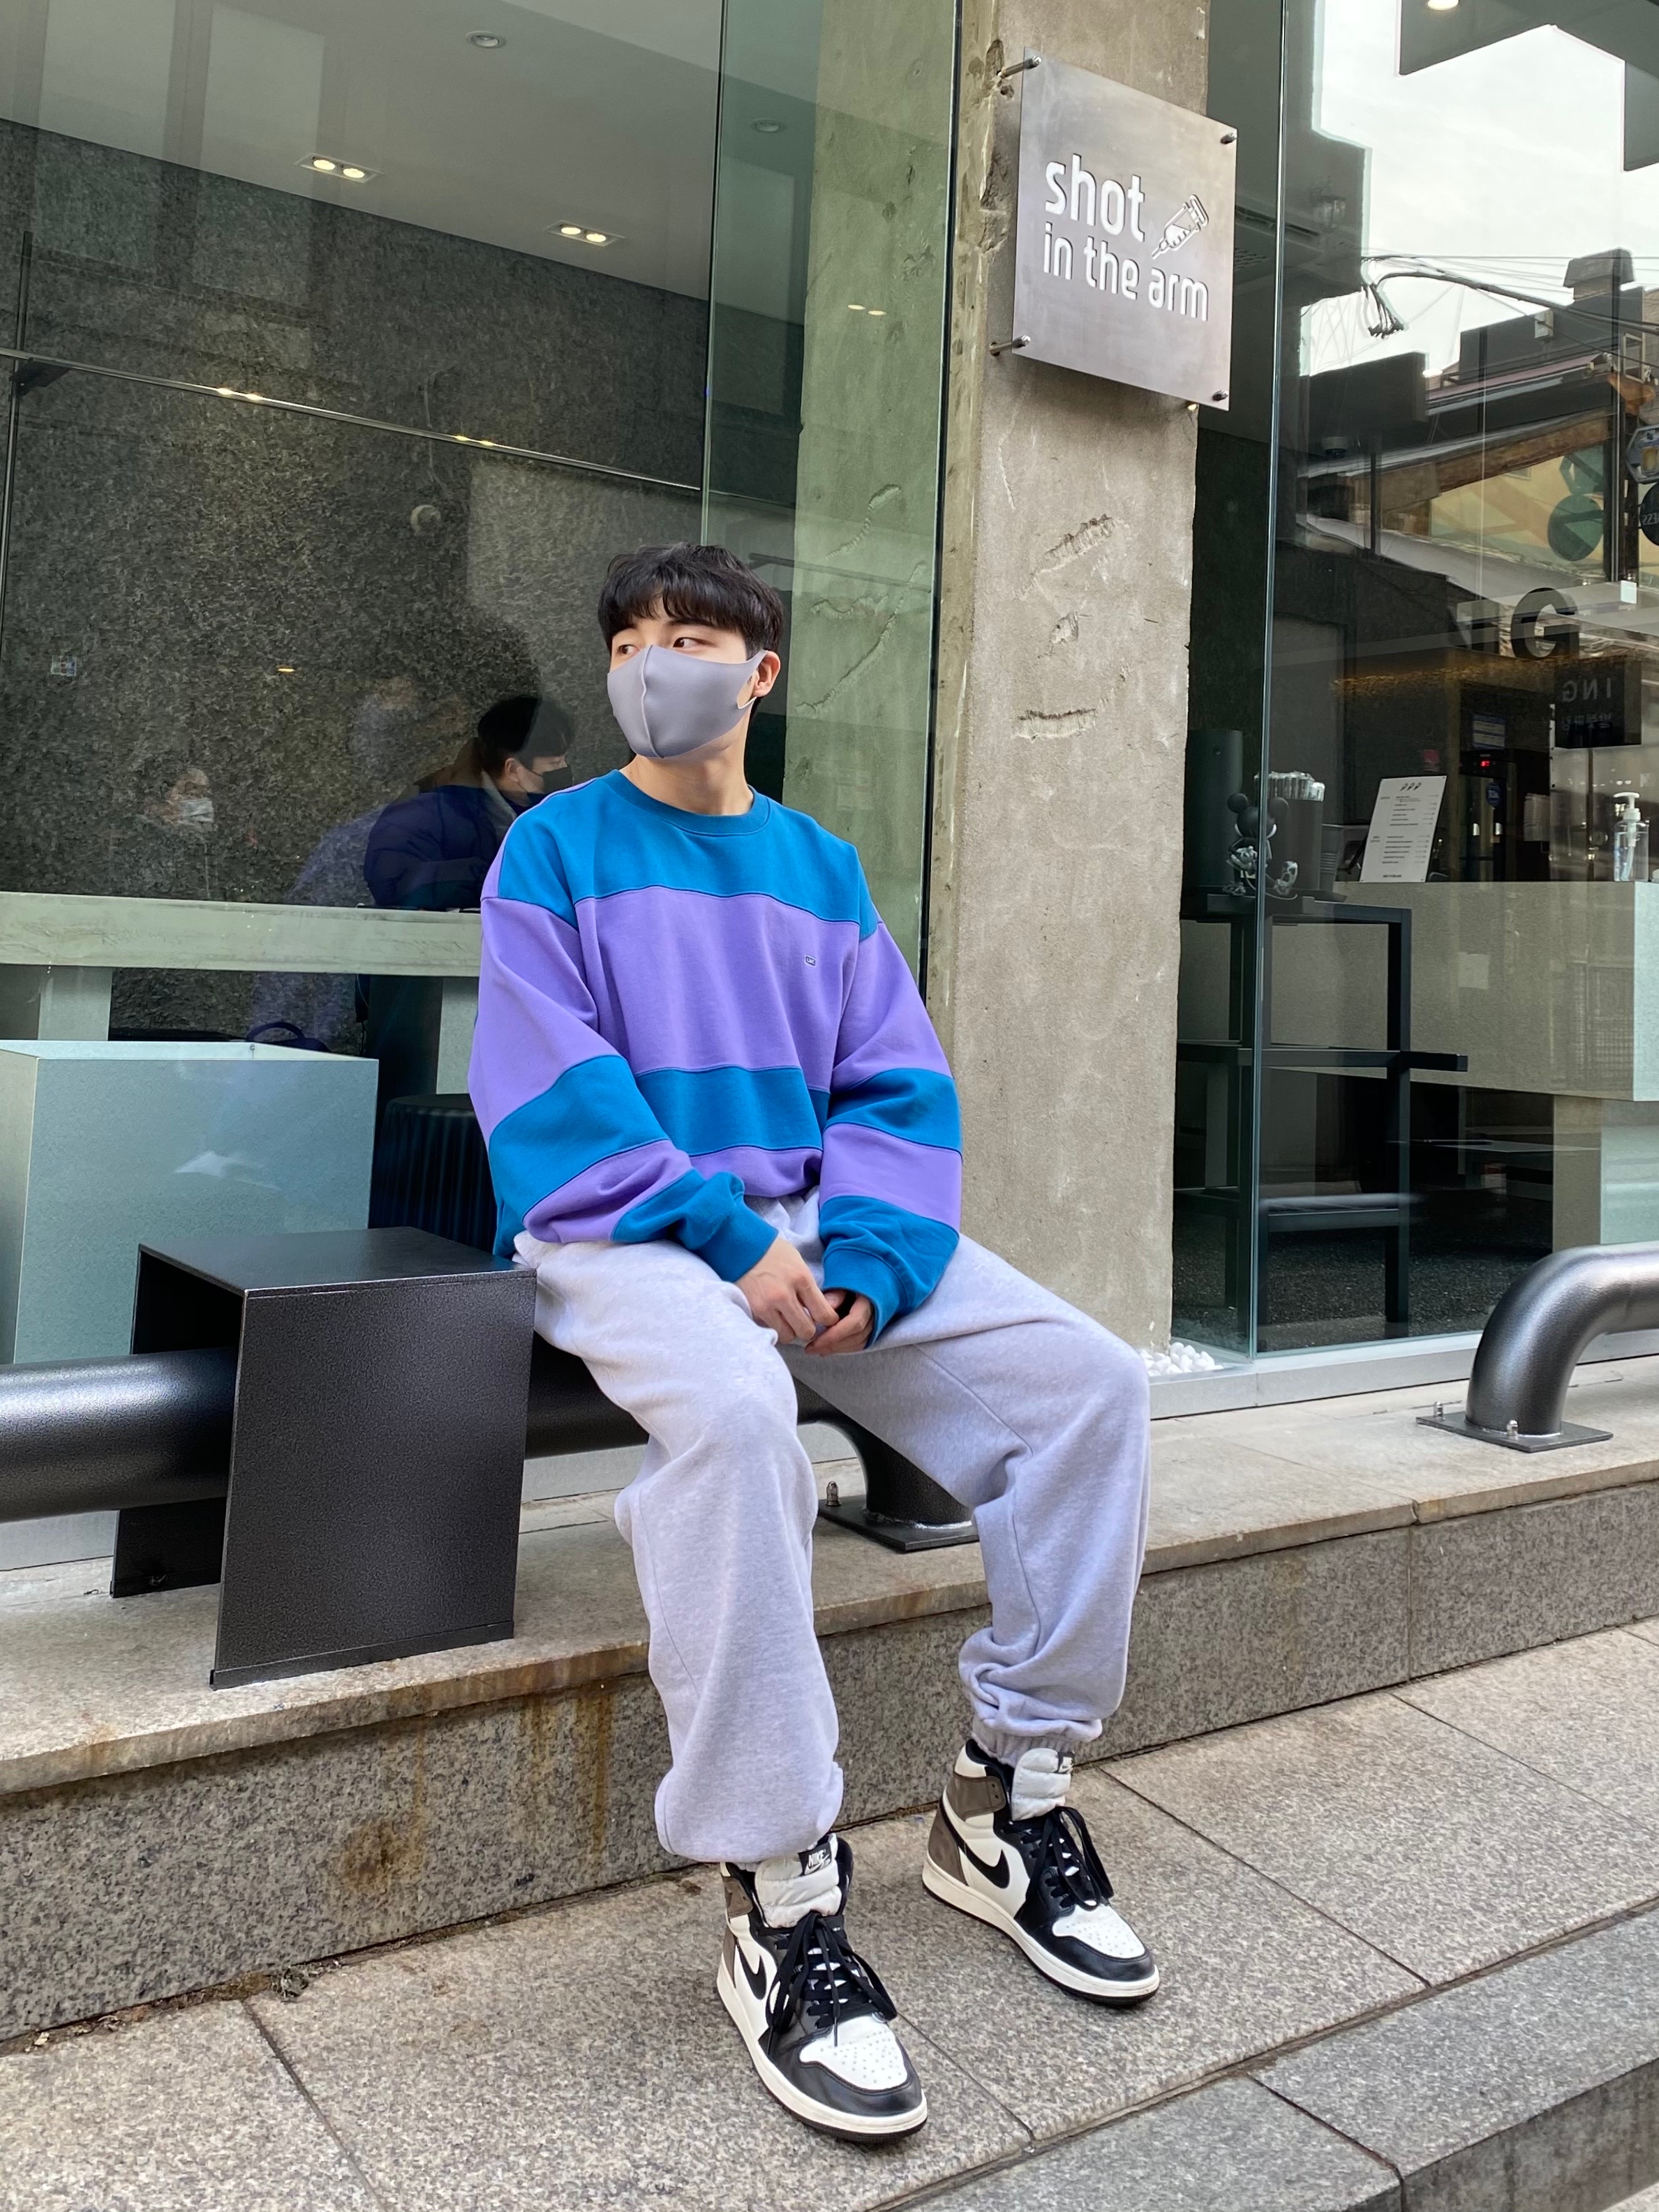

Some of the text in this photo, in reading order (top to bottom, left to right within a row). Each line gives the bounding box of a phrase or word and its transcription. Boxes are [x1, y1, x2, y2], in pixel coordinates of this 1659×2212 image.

[1045, 153, 1145, 243] shot
[1043, 221, 1210, 322] in the arm
[808, 1849, 824, 1867] NIKE
